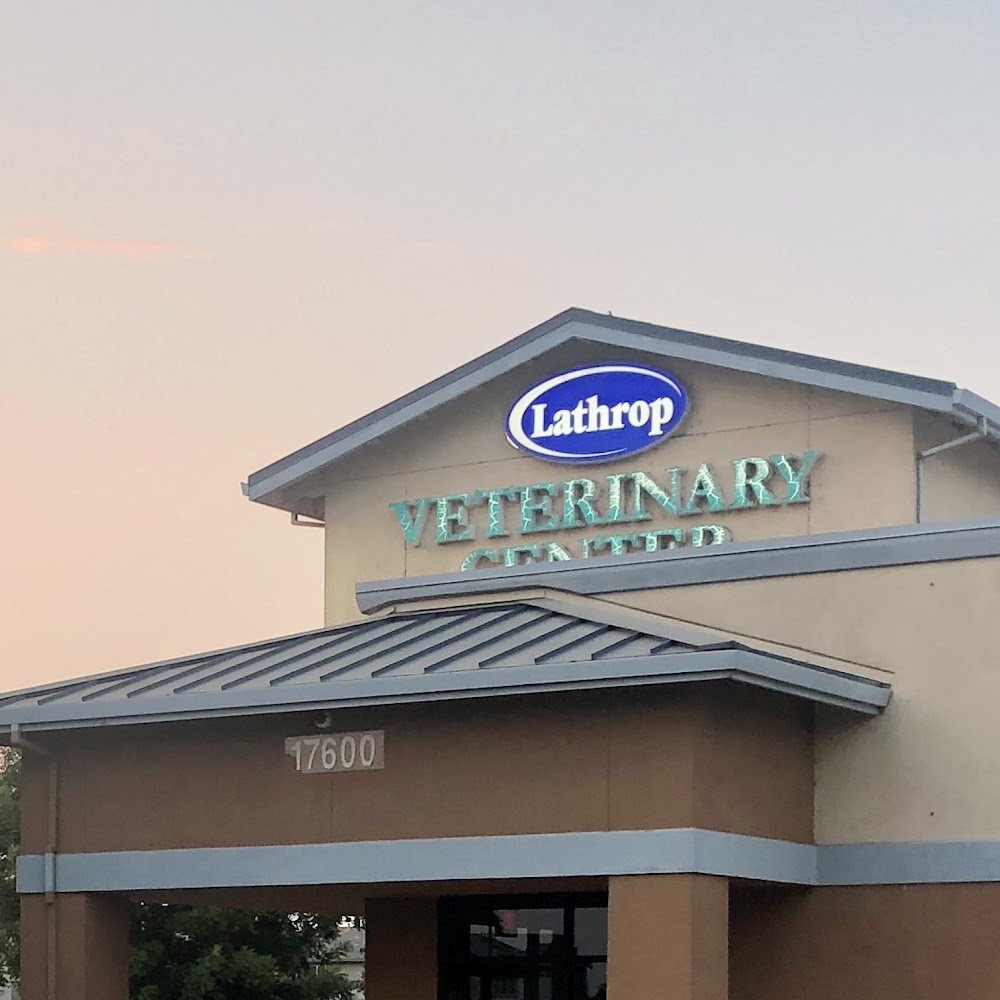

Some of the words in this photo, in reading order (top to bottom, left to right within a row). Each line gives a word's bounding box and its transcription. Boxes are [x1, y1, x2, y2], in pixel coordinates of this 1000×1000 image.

[531, 394, 675, 438] Lathrop
[390, 451, 820, 546] VETERINARY
[290, 734, 376, 771] 17600
